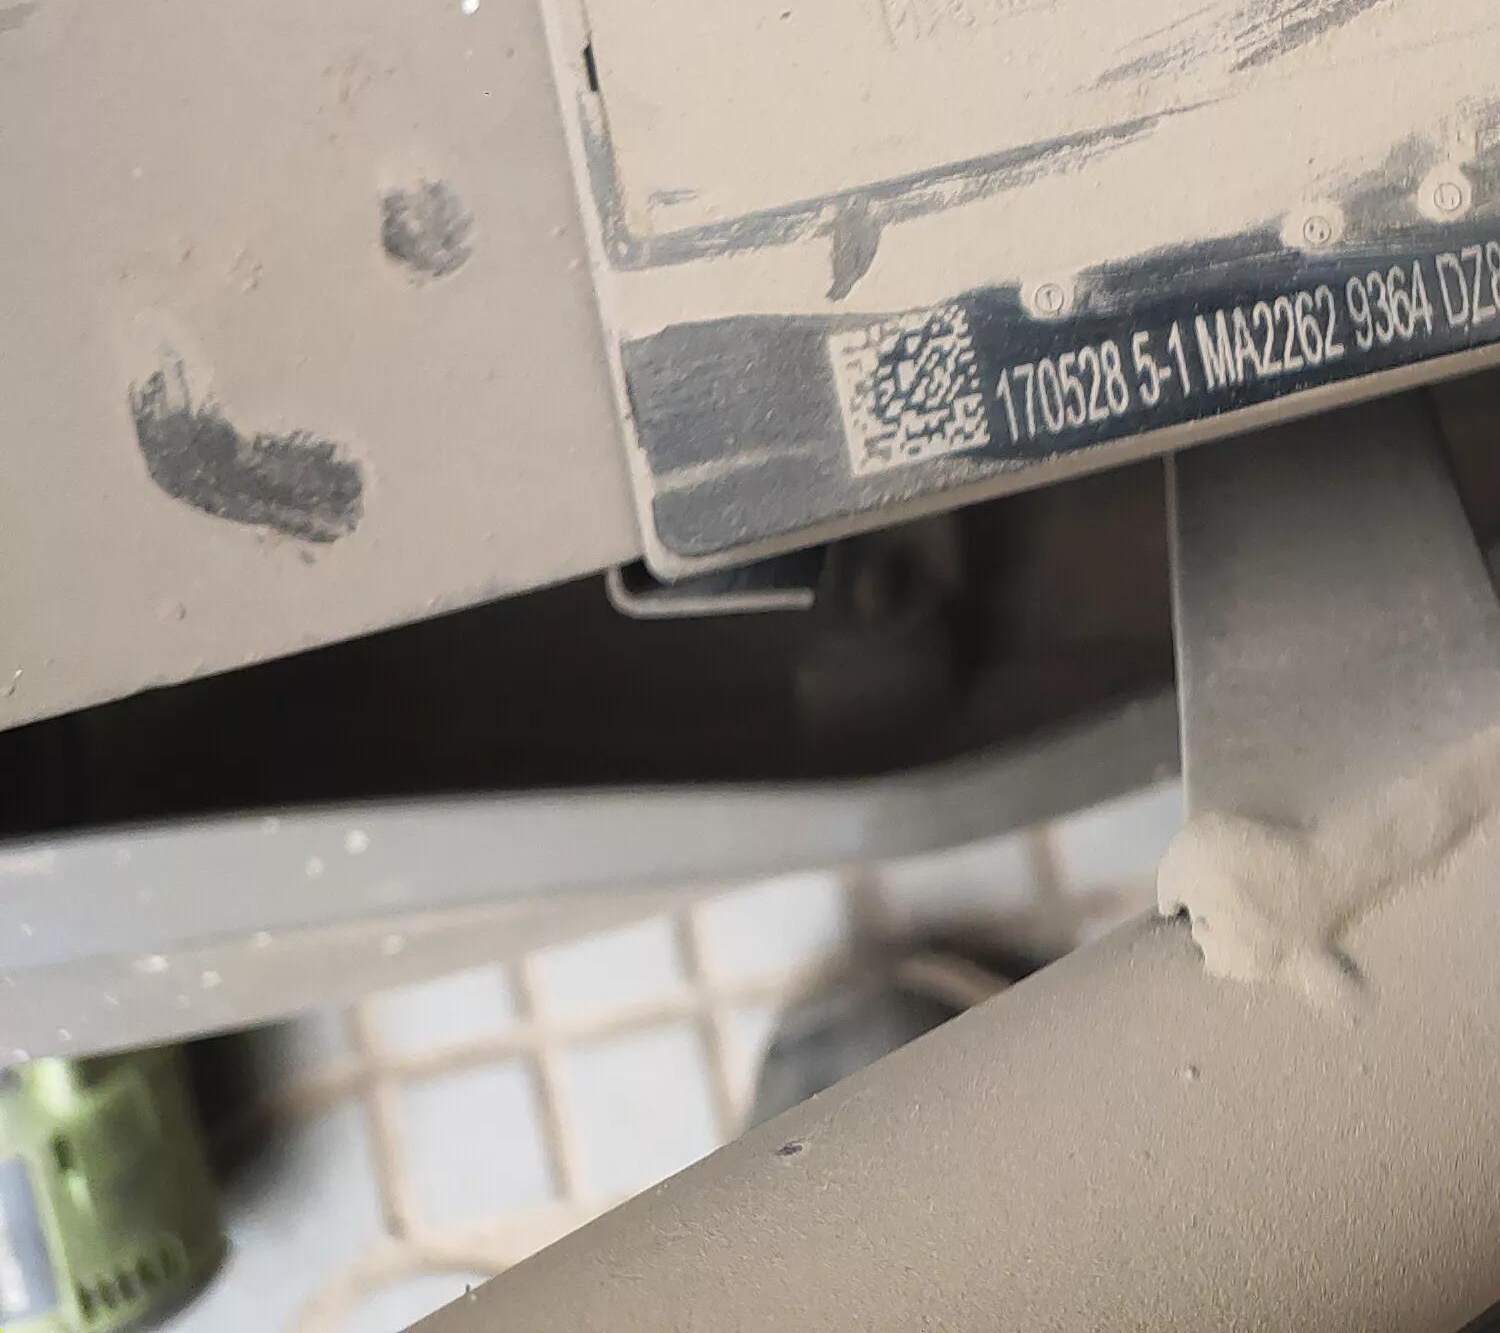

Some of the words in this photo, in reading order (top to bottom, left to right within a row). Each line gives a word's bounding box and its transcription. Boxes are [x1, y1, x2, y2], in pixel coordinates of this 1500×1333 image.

[996, 339, 1130, 445] 170528
[1131, 320, 1191, 405] 5-1
[1194, 284, 1345, 394] MA2262
[1346, 259, 1434, 350] 9364
